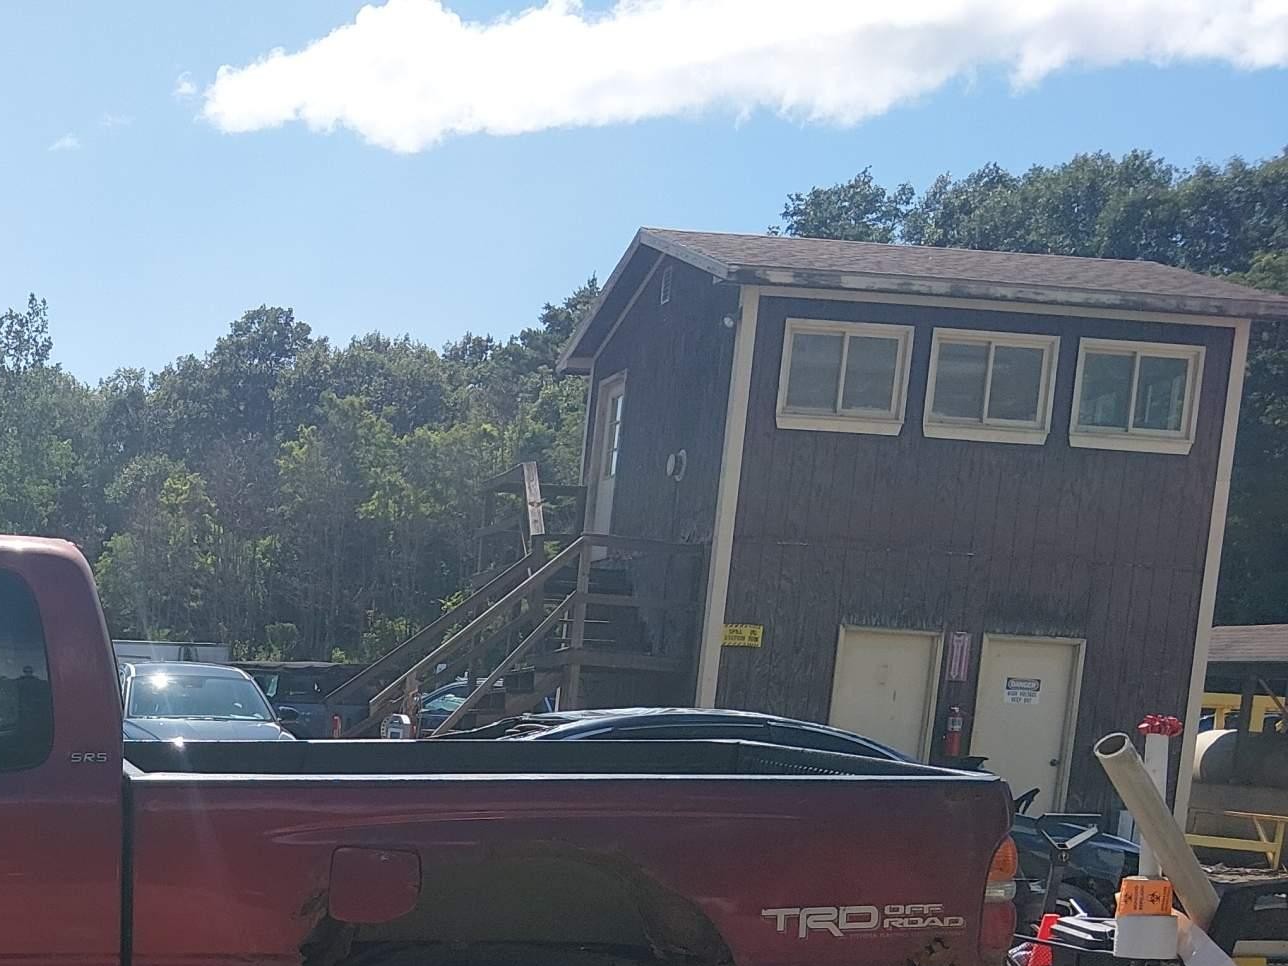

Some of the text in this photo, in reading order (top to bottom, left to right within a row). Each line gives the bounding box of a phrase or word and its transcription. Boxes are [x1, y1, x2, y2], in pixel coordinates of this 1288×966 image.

[883, 903, 944, 916] OFF
[761, 905, 880, 939] TRD
[883, 916, 966, 929] ROAD
